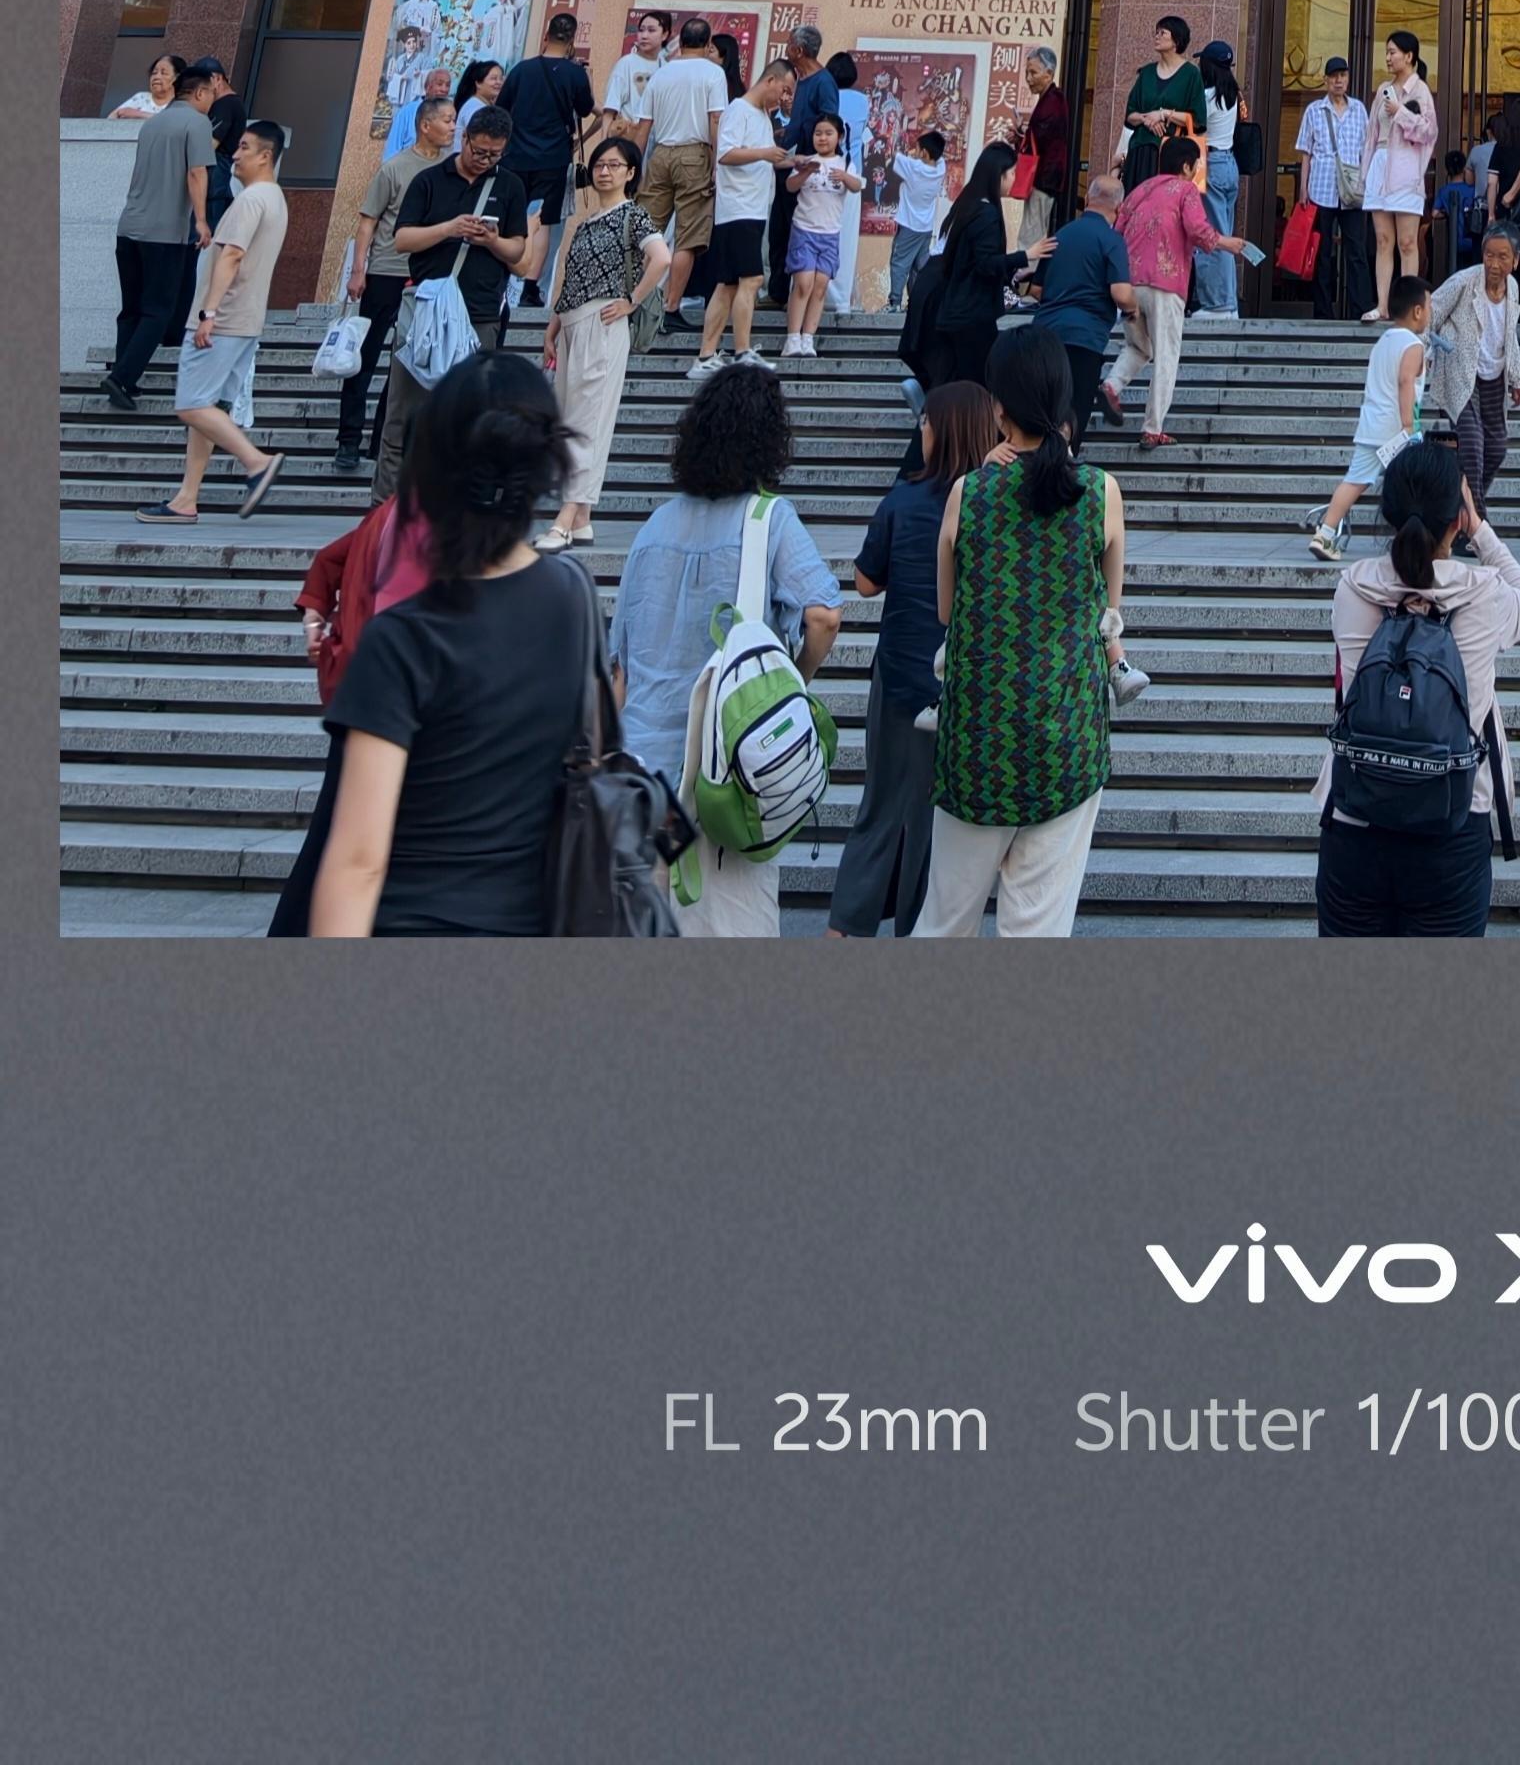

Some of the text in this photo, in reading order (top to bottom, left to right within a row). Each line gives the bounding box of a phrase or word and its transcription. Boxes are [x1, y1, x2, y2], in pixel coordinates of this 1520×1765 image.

[892, 12, 1056, 38] OF CHANG'AN
[989, 45, 1021, 145] 铡美案
